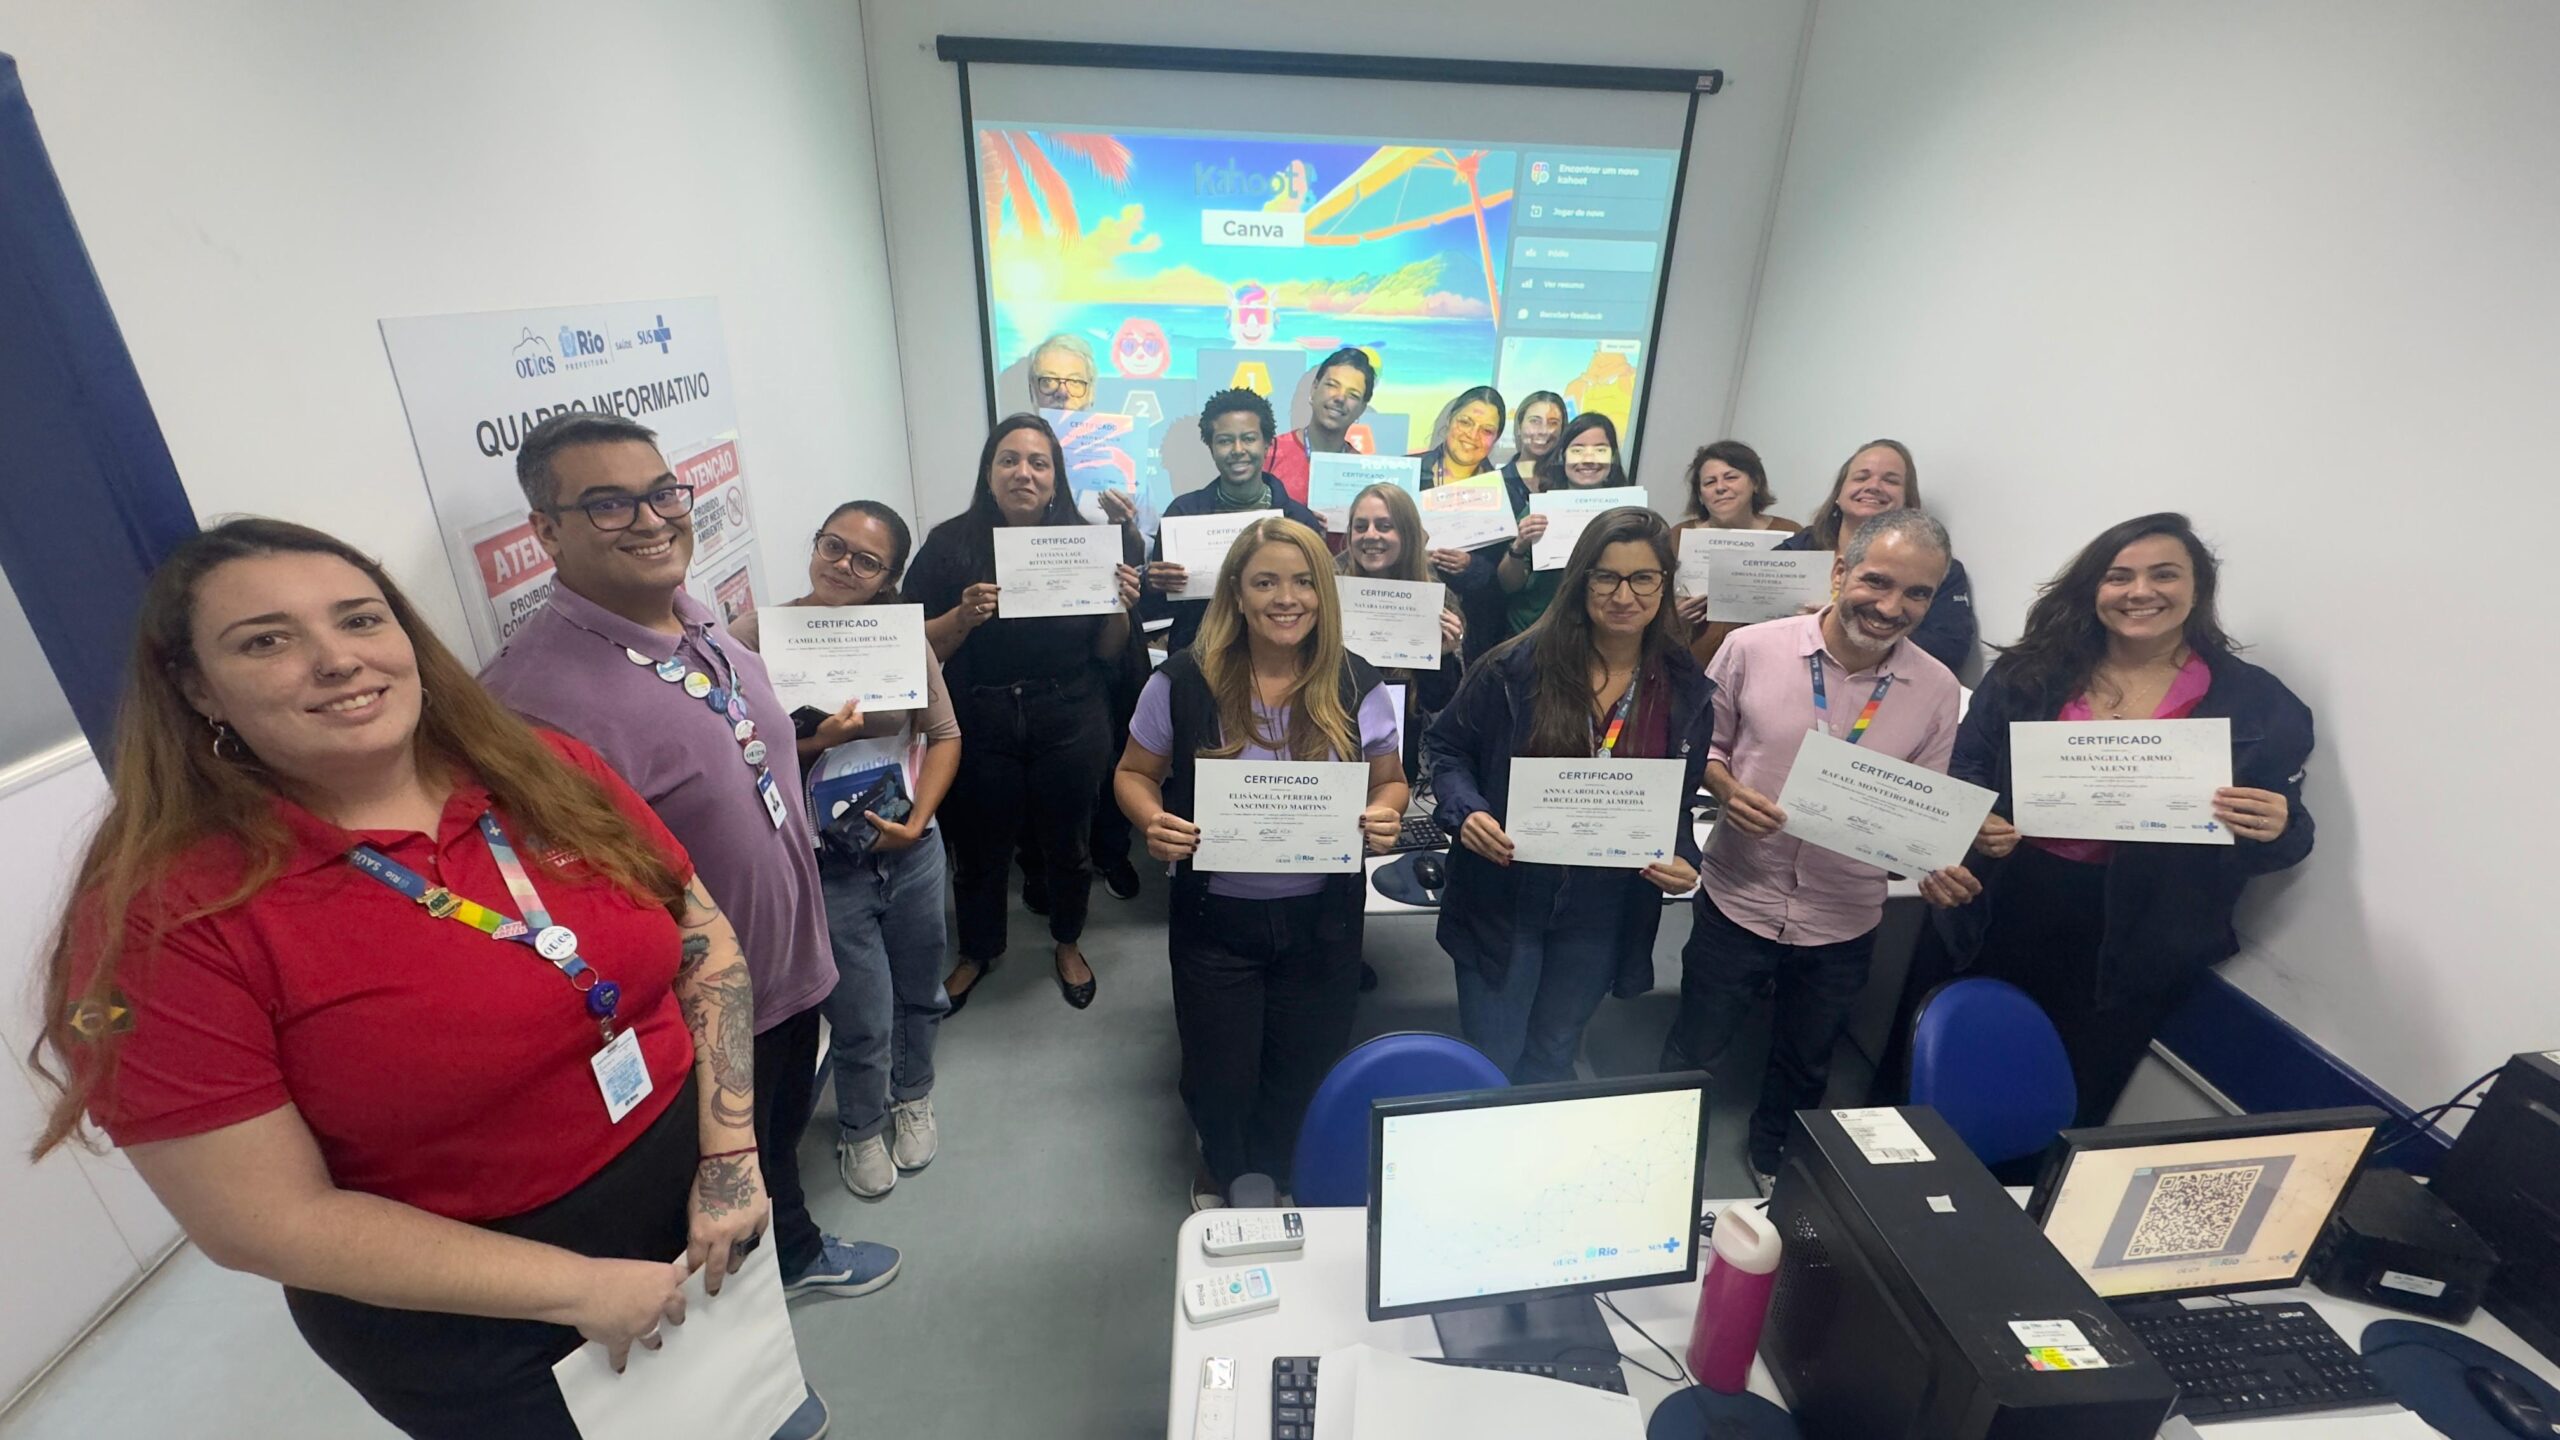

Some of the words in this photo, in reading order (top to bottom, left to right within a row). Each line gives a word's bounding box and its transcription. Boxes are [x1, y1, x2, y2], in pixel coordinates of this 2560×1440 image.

[1559, 164, 1600, 175] Encontrar
[1602, 165, 1617, 175] um
[1618, 168, 1639, 176] novo
[1557, 176, 1588, 185] kahoot
[1223, 220, 1284, 238] Canva
[576, 330, 605, 356] Rio
[565, 359, 609, 371] PREFEITURA
[1247, 372, 1256, 391] 1
[592, 371, 710, 418] INFORMATIVO
[1136, 400, 1149, 417] 2
[685, 449, 733, 489] ATENÇÃO
[1342, 471, 1385, 480] CERTIFICADO
[1031, 537, 1086, 545] CERTIFICADO
[1708, 539, 1755, 548] CERTIFICADO
[493, 534, 549, 584] ATEN
[1742, 560, 1797, 568] CERTIFICADO
[1361, 589, 1411, 599] CERTIFICADO
[807, 619, 878, 629] CERTIFICADO
[788, 636, 826, 645] CAMILLA
[827, 636, 842, 644] DEL
[2068, 735, 2162, 745] CERTIFICADO
[2091, 765, 2139, 773] VALENTE
[1244, 775, 1319, 785] CERTIFICADO
[1558, 771, 1633, 781] CERTIFICADO
[1850, 760, 1933, 795] CERTIFICADO
[1821, 768, 1856, 786] RAFAEL
[1858, 781, 1907, 803] MONTEIRO
[1908, 798, 1950, 818] BALEIXO
[1233, 803, 1287, 811] NASCIMENTO
[2150, 821, 2167, 829] Rio
[1598, 1247, 1618, 1257] Rio
